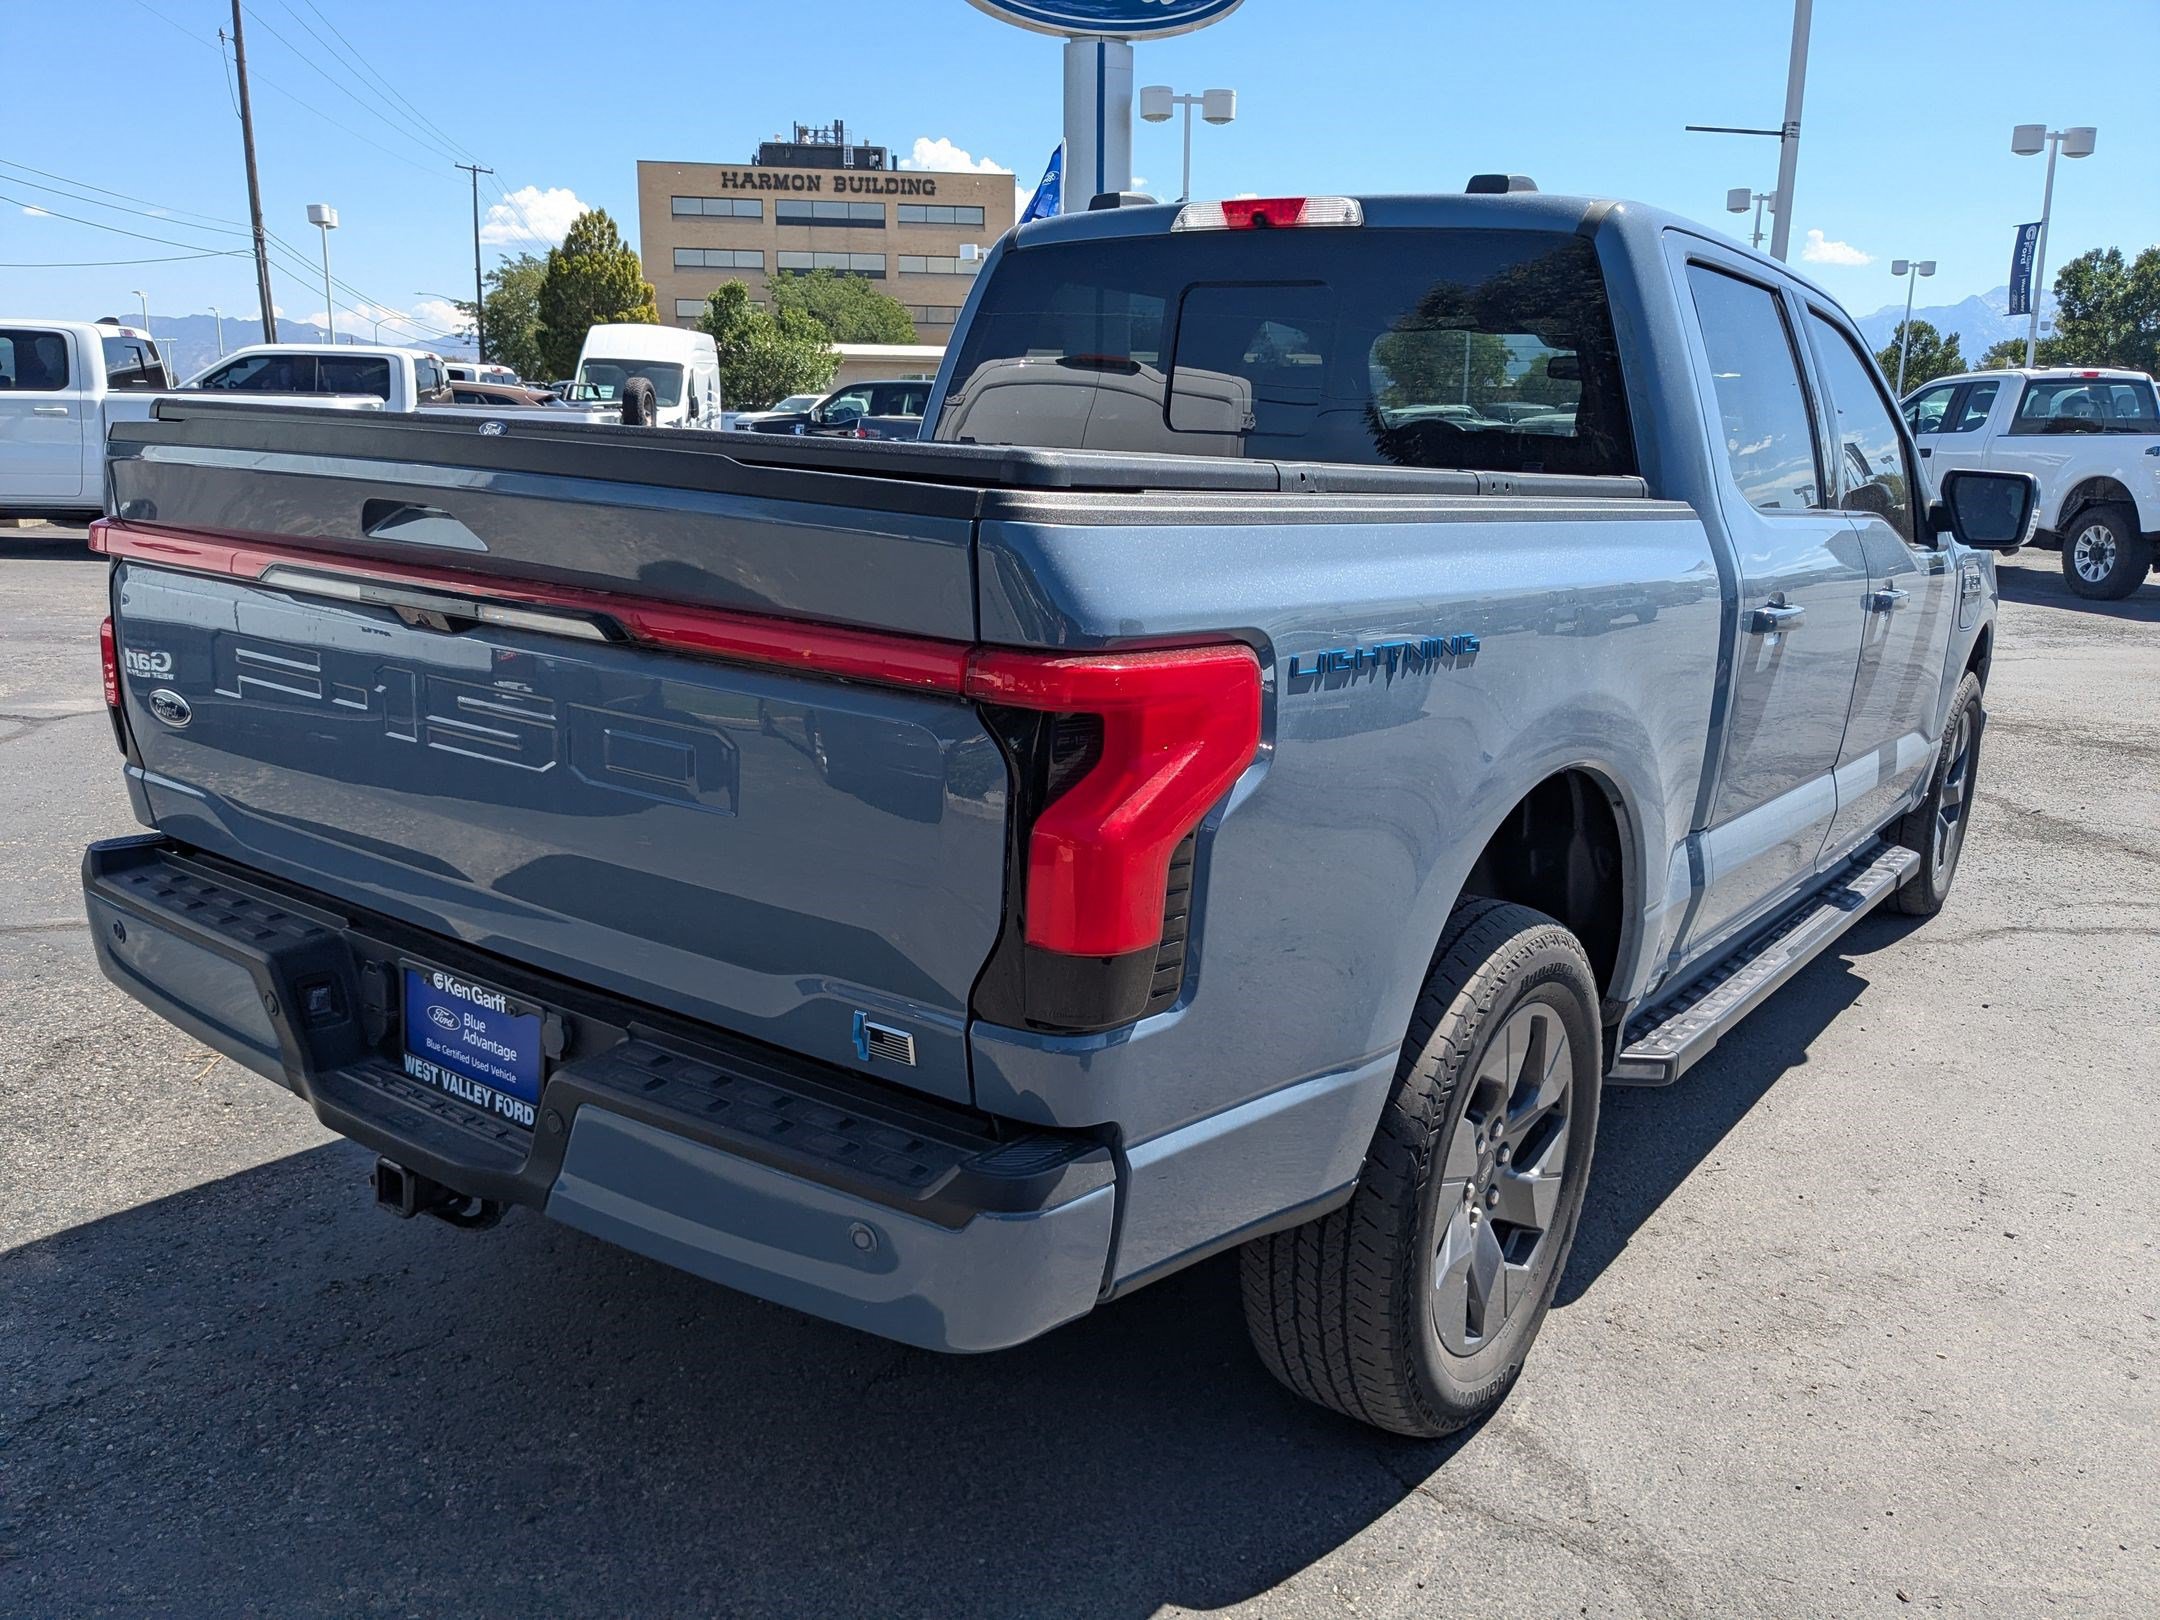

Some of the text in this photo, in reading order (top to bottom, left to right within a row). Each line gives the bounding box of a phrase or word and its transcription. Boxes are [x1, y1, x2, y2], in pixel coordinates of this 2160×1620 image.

[721, 171, 936, 196] HARMON BUILDING
[2020, 241, 2029, 265] Ford
[1290, 633, 1481, 678] LIGHTNING
[213, 629, 740, 818] F-150
[444, 975, 507, 1014] Ken Garff
[433, 1008, 455, 1028] Ford
[463, 1012, 487, 1033] Blue
[426, 1037, 517, 1084] Blue Certified Used Vehicle
[462, 1029, 518, 1062] Advantage
[403, 1053, 535, 1126] WEST VALLEY FORD
